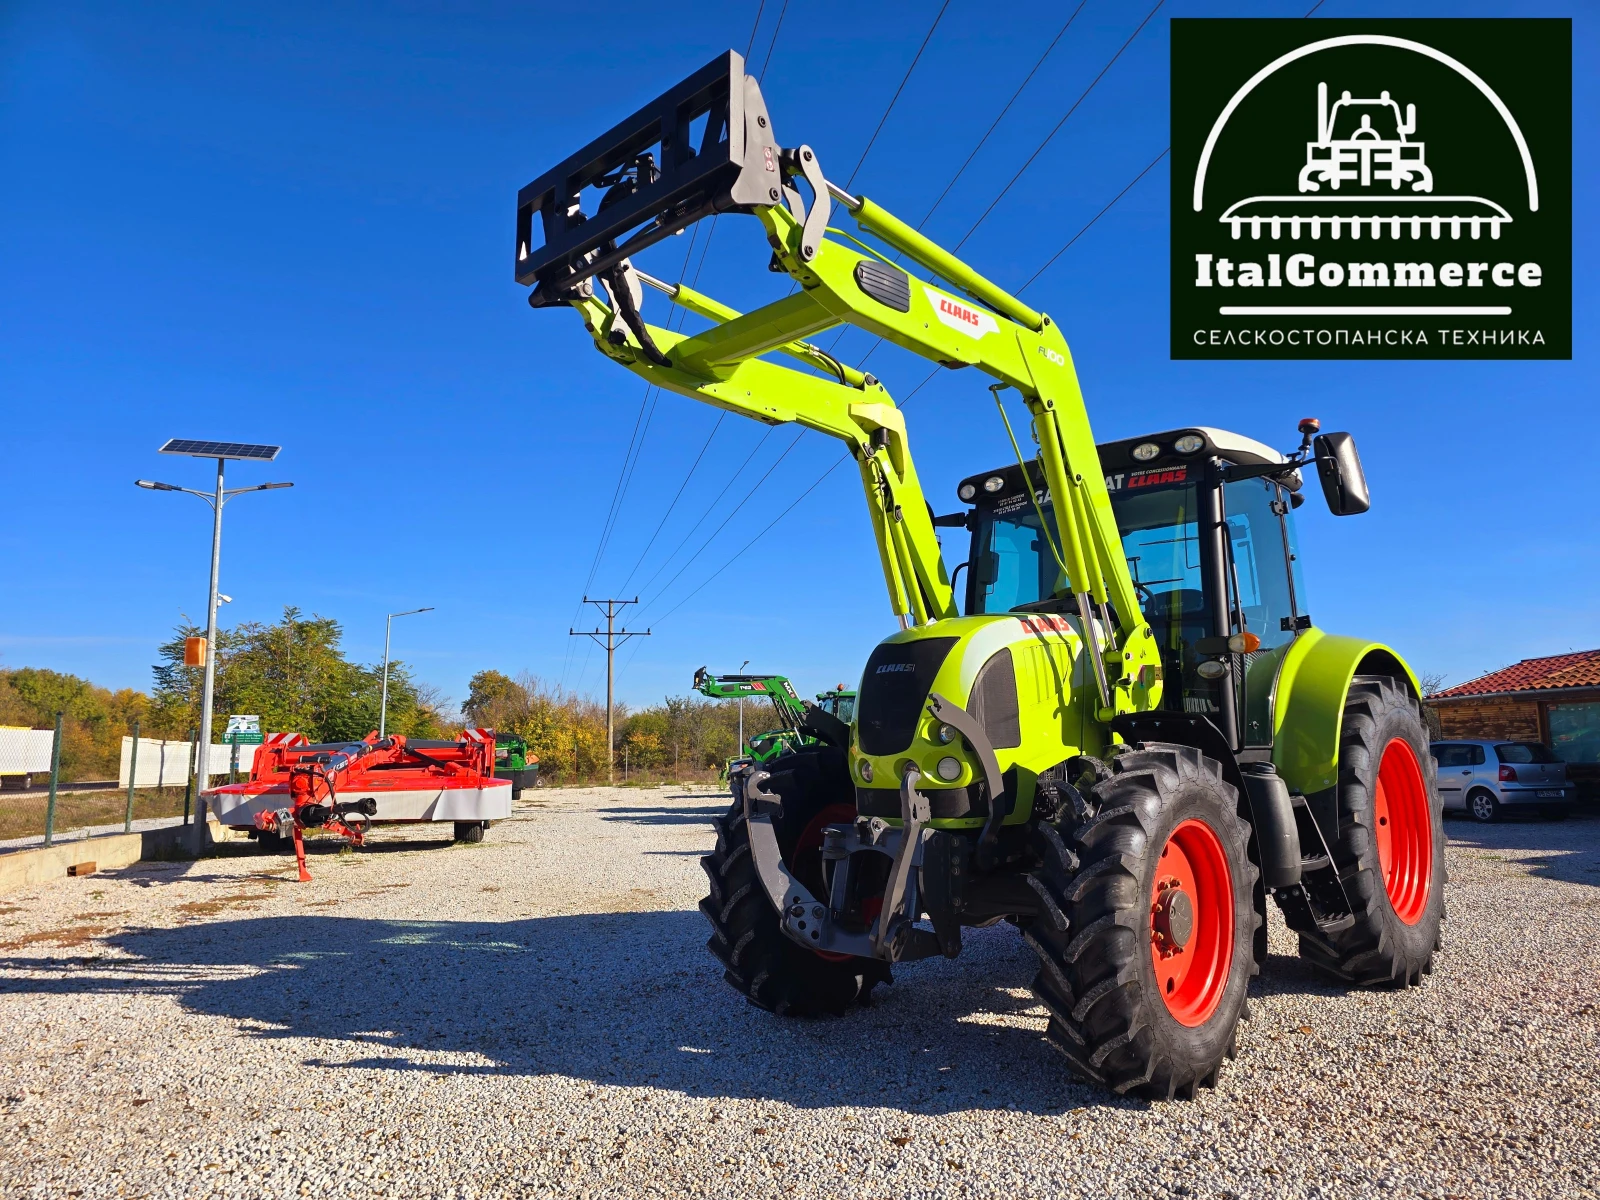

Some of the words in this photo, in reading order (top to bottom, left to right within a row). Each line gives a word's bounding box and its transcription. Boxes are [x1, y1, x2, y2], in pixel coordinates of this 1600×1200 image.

[939, 298, 979, 327] CLAAS
[1128, 469, 1188, 489] CLAAS
[1020, 617, 1070, 634] CLAAS
[876, 663, 914, 674] CLAAS
